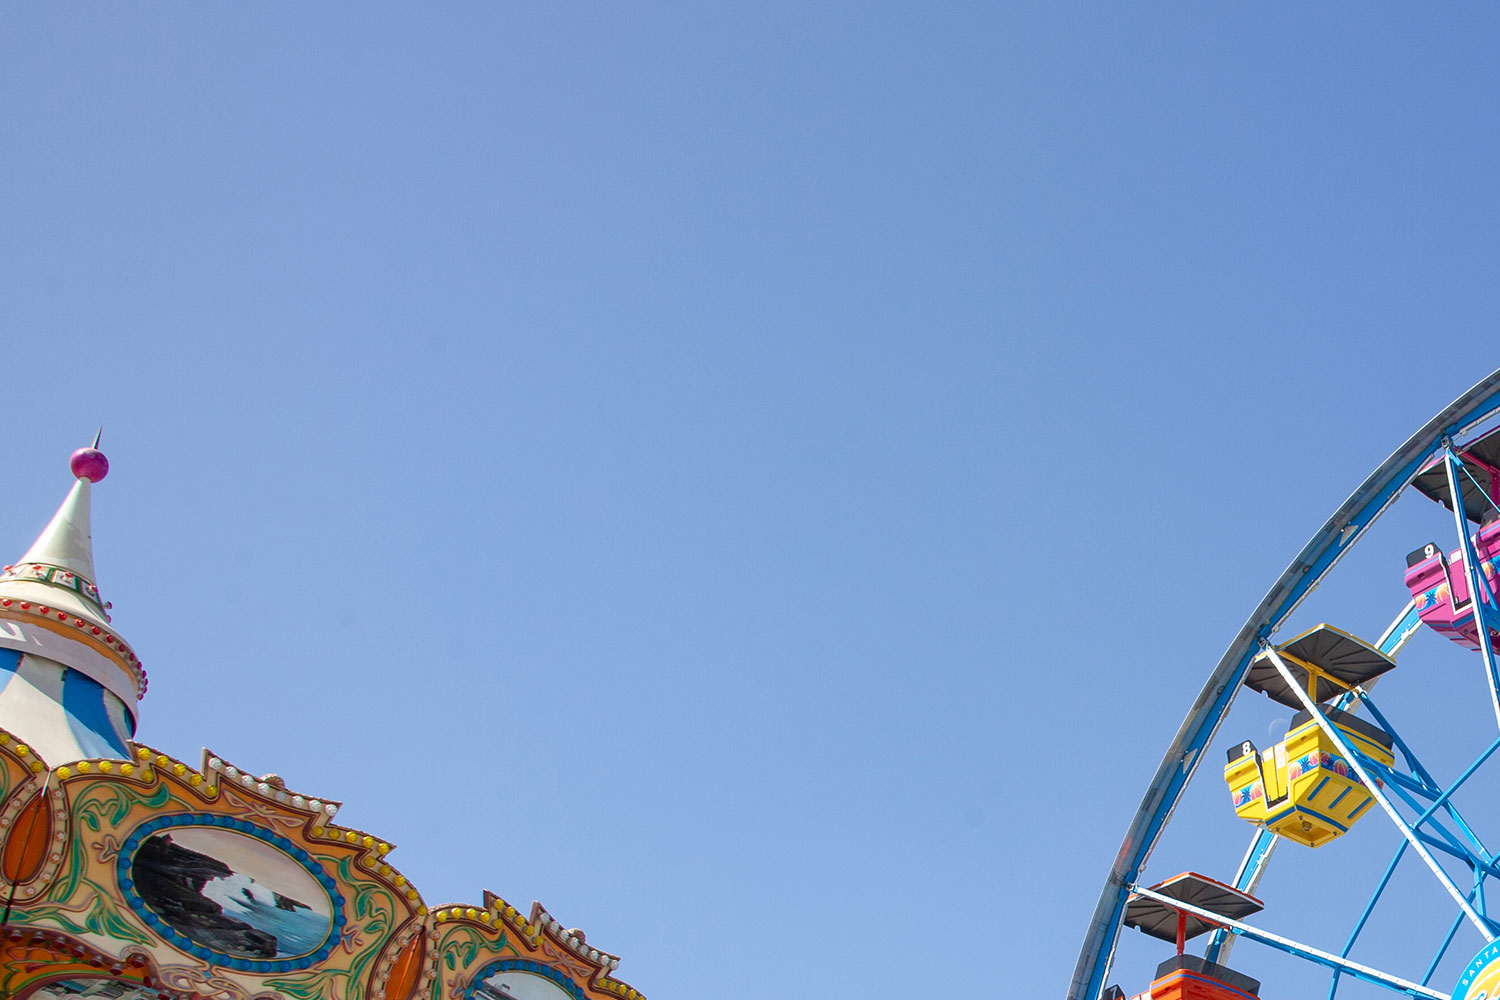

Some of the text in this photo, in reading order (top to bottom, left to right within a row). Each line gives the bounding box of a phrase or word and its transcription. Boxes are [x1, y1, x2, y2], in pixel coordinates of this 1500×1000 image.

[1424, 544, 1435, 558] 9
[1242, 742, 1251, 756] 8
[1462, 946, 1499, 986] SANTA
[1109, 985, 1118, 1000] 7
